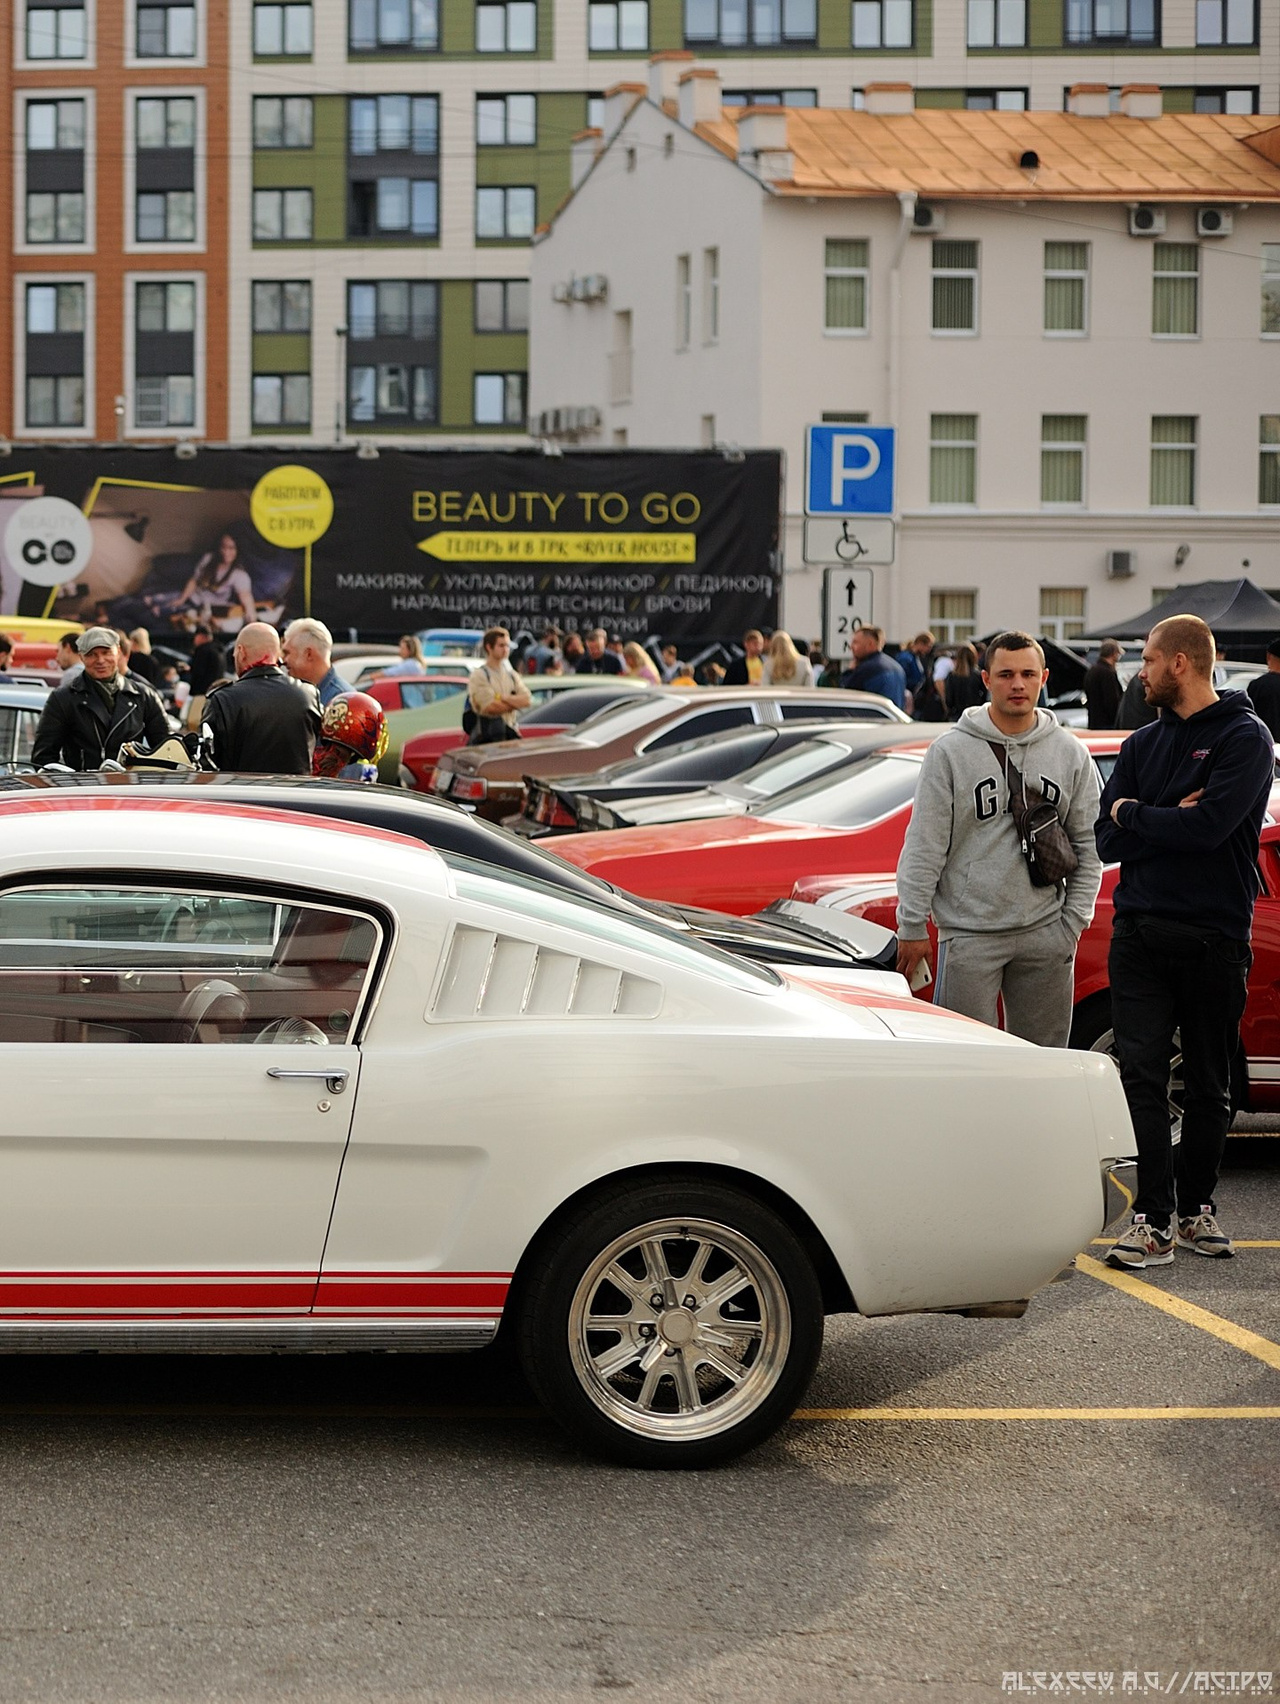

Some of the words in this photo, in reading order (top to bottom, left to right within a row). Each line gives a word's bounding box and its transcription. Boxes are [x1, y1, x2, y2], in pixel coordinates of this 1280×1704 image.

[831, 434, 881, 506] P
[412, 490, 567, 524] BEAUTY
[578, 490, 629, 524] TO
[640, 491, 702, 525] GO
[446, 538, 503, 555] ТЕПЕРЬ
[336, 574, 424, 590] МАКИЯЖ
[443, 574, 534, 592] УКЛАДКИ
[554, 574, 655, 592] МАНИКЮР
[392, 595, 541, 612] НАРАЩИВАНИЕ
[546, 595, 626, 613] РЕСНИЦ
[645, 595, 712, 613] БРОВИ
[598, 616, 649, 633] РУКИ
[973, 773, 1063, 822] GP
